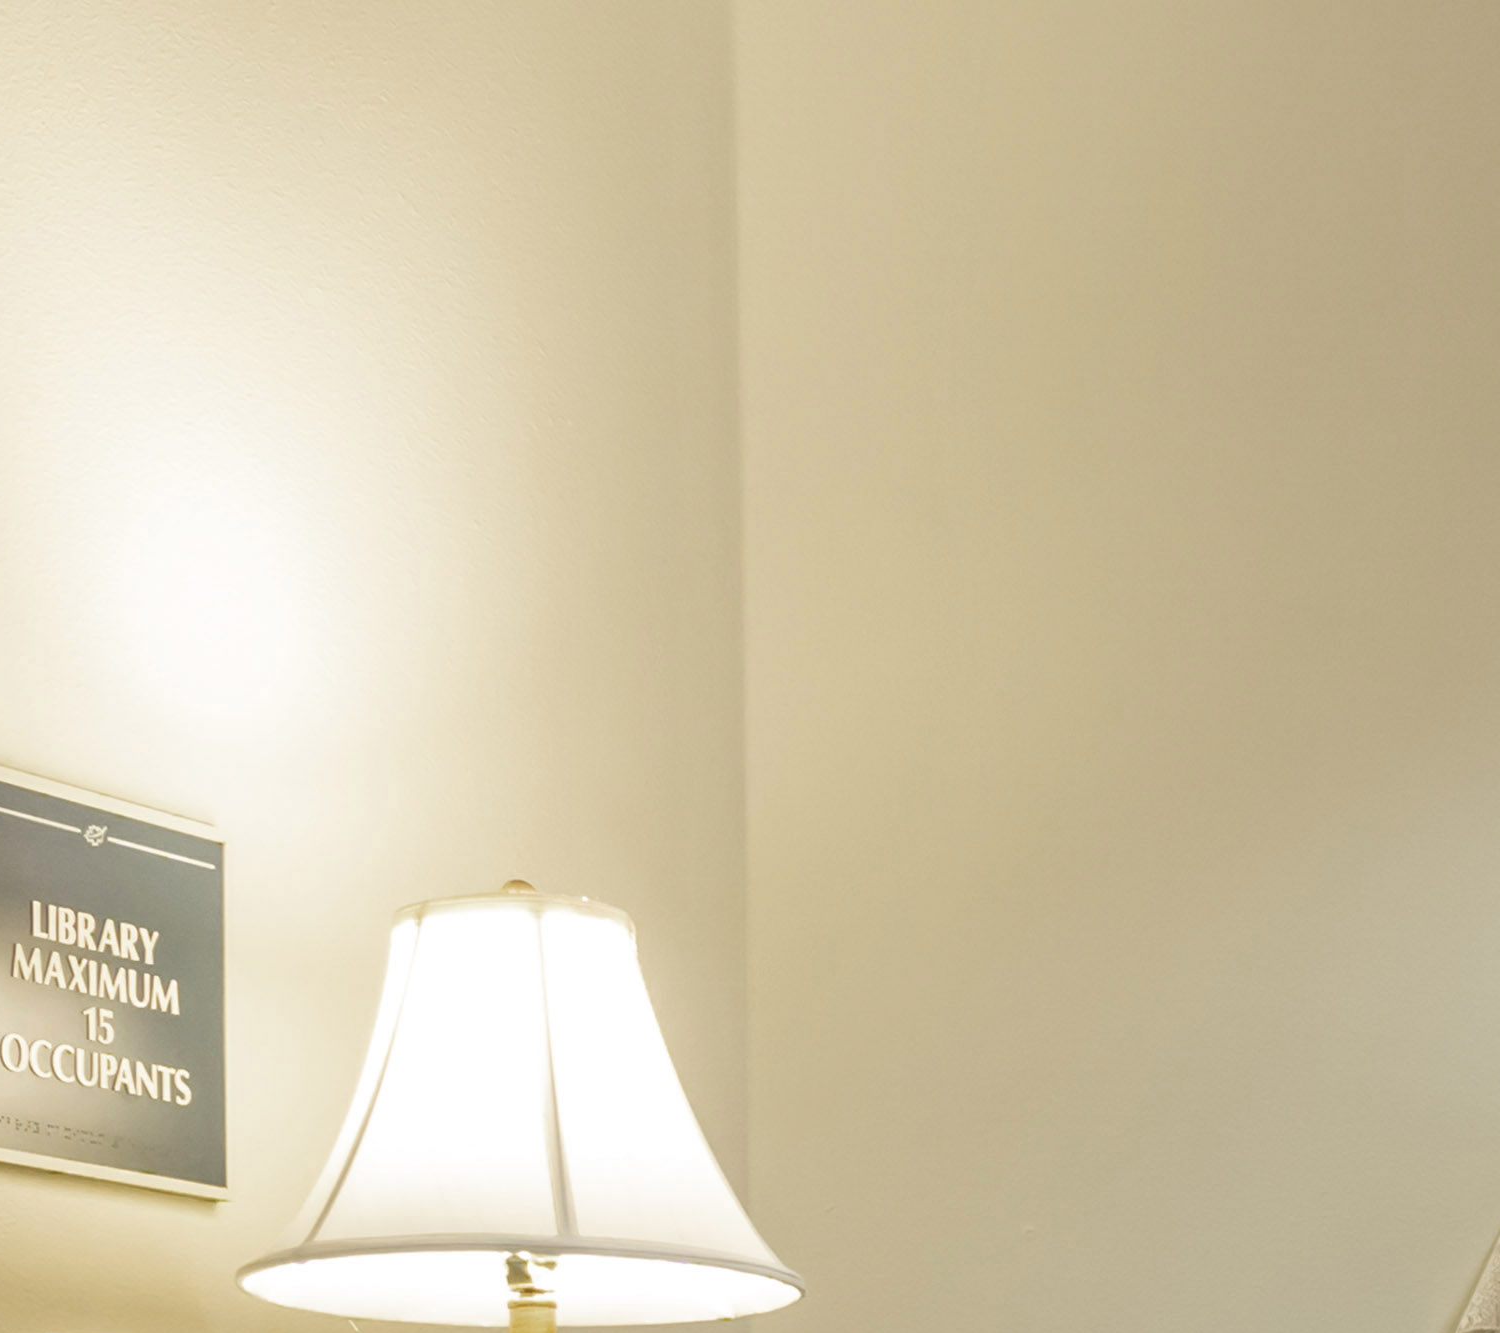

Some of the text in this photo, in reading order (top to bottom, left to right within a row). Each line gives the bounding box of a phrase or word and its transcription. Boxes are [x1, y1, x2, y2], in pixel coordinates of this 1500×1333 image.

[31, 900, 160, 966] LIBRARY
[11, 943, 181, 1016] MAXIMUM
[82, 1005, 115, 1045] 15
[0, 1032, 193, 1106] OCCUPANTS
